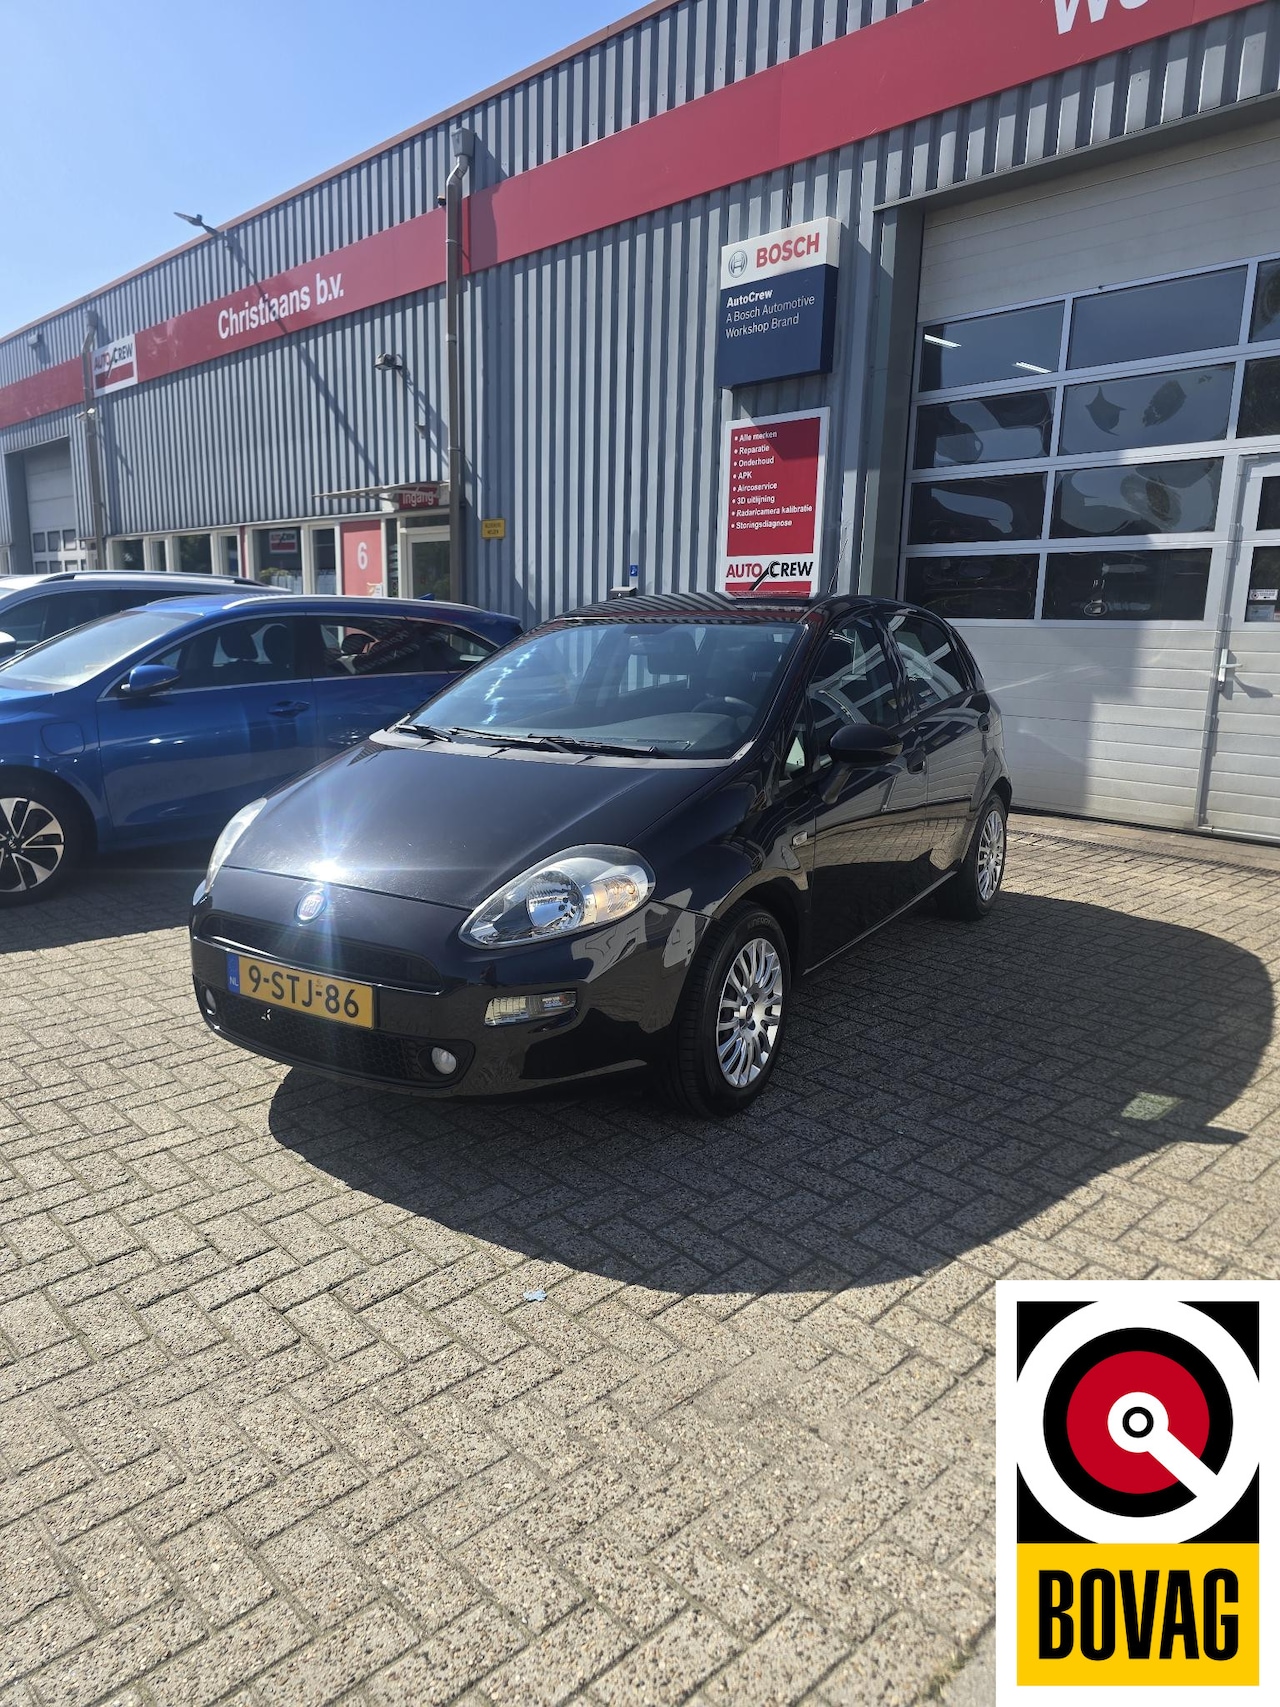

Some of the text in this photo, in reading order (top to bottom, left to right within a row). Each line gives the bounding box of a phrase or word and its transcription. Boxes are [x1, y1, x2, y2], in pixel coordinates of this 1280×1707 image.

[756, 232, 820, 268] BOSCH
[218, 273, 344, 339] Christiaans b.v.
[726, 289, 773, 308] AutoCrew
[726, 295, 815, 324] A Bosch Automotive
[725, 313, 800, 339] Workshop Brand
[114, 343, 133, 363] CREW
[739, 431, 777, 442] Alle merken
[739, 444, 770, 455] Reparatie
[738, 456, 774, 467] Onderhoud
[738, 471, 752, 480] APK
[737, 482, 777, 492] Aircoservice
[402, 491, 434, 507] Ingang
[747, 495, 775, 505] uitlijning
[781, 504, 813, 514] kalibratie
[736, 519, 792, 530] Storingsdiagnose
[357, 541, 368, 570] 6
[726, 561, 814, 578] AUTO CREW
[229, 976, 239, 987] NL
[248, 965, 359, 1018] 9-STJ-86
